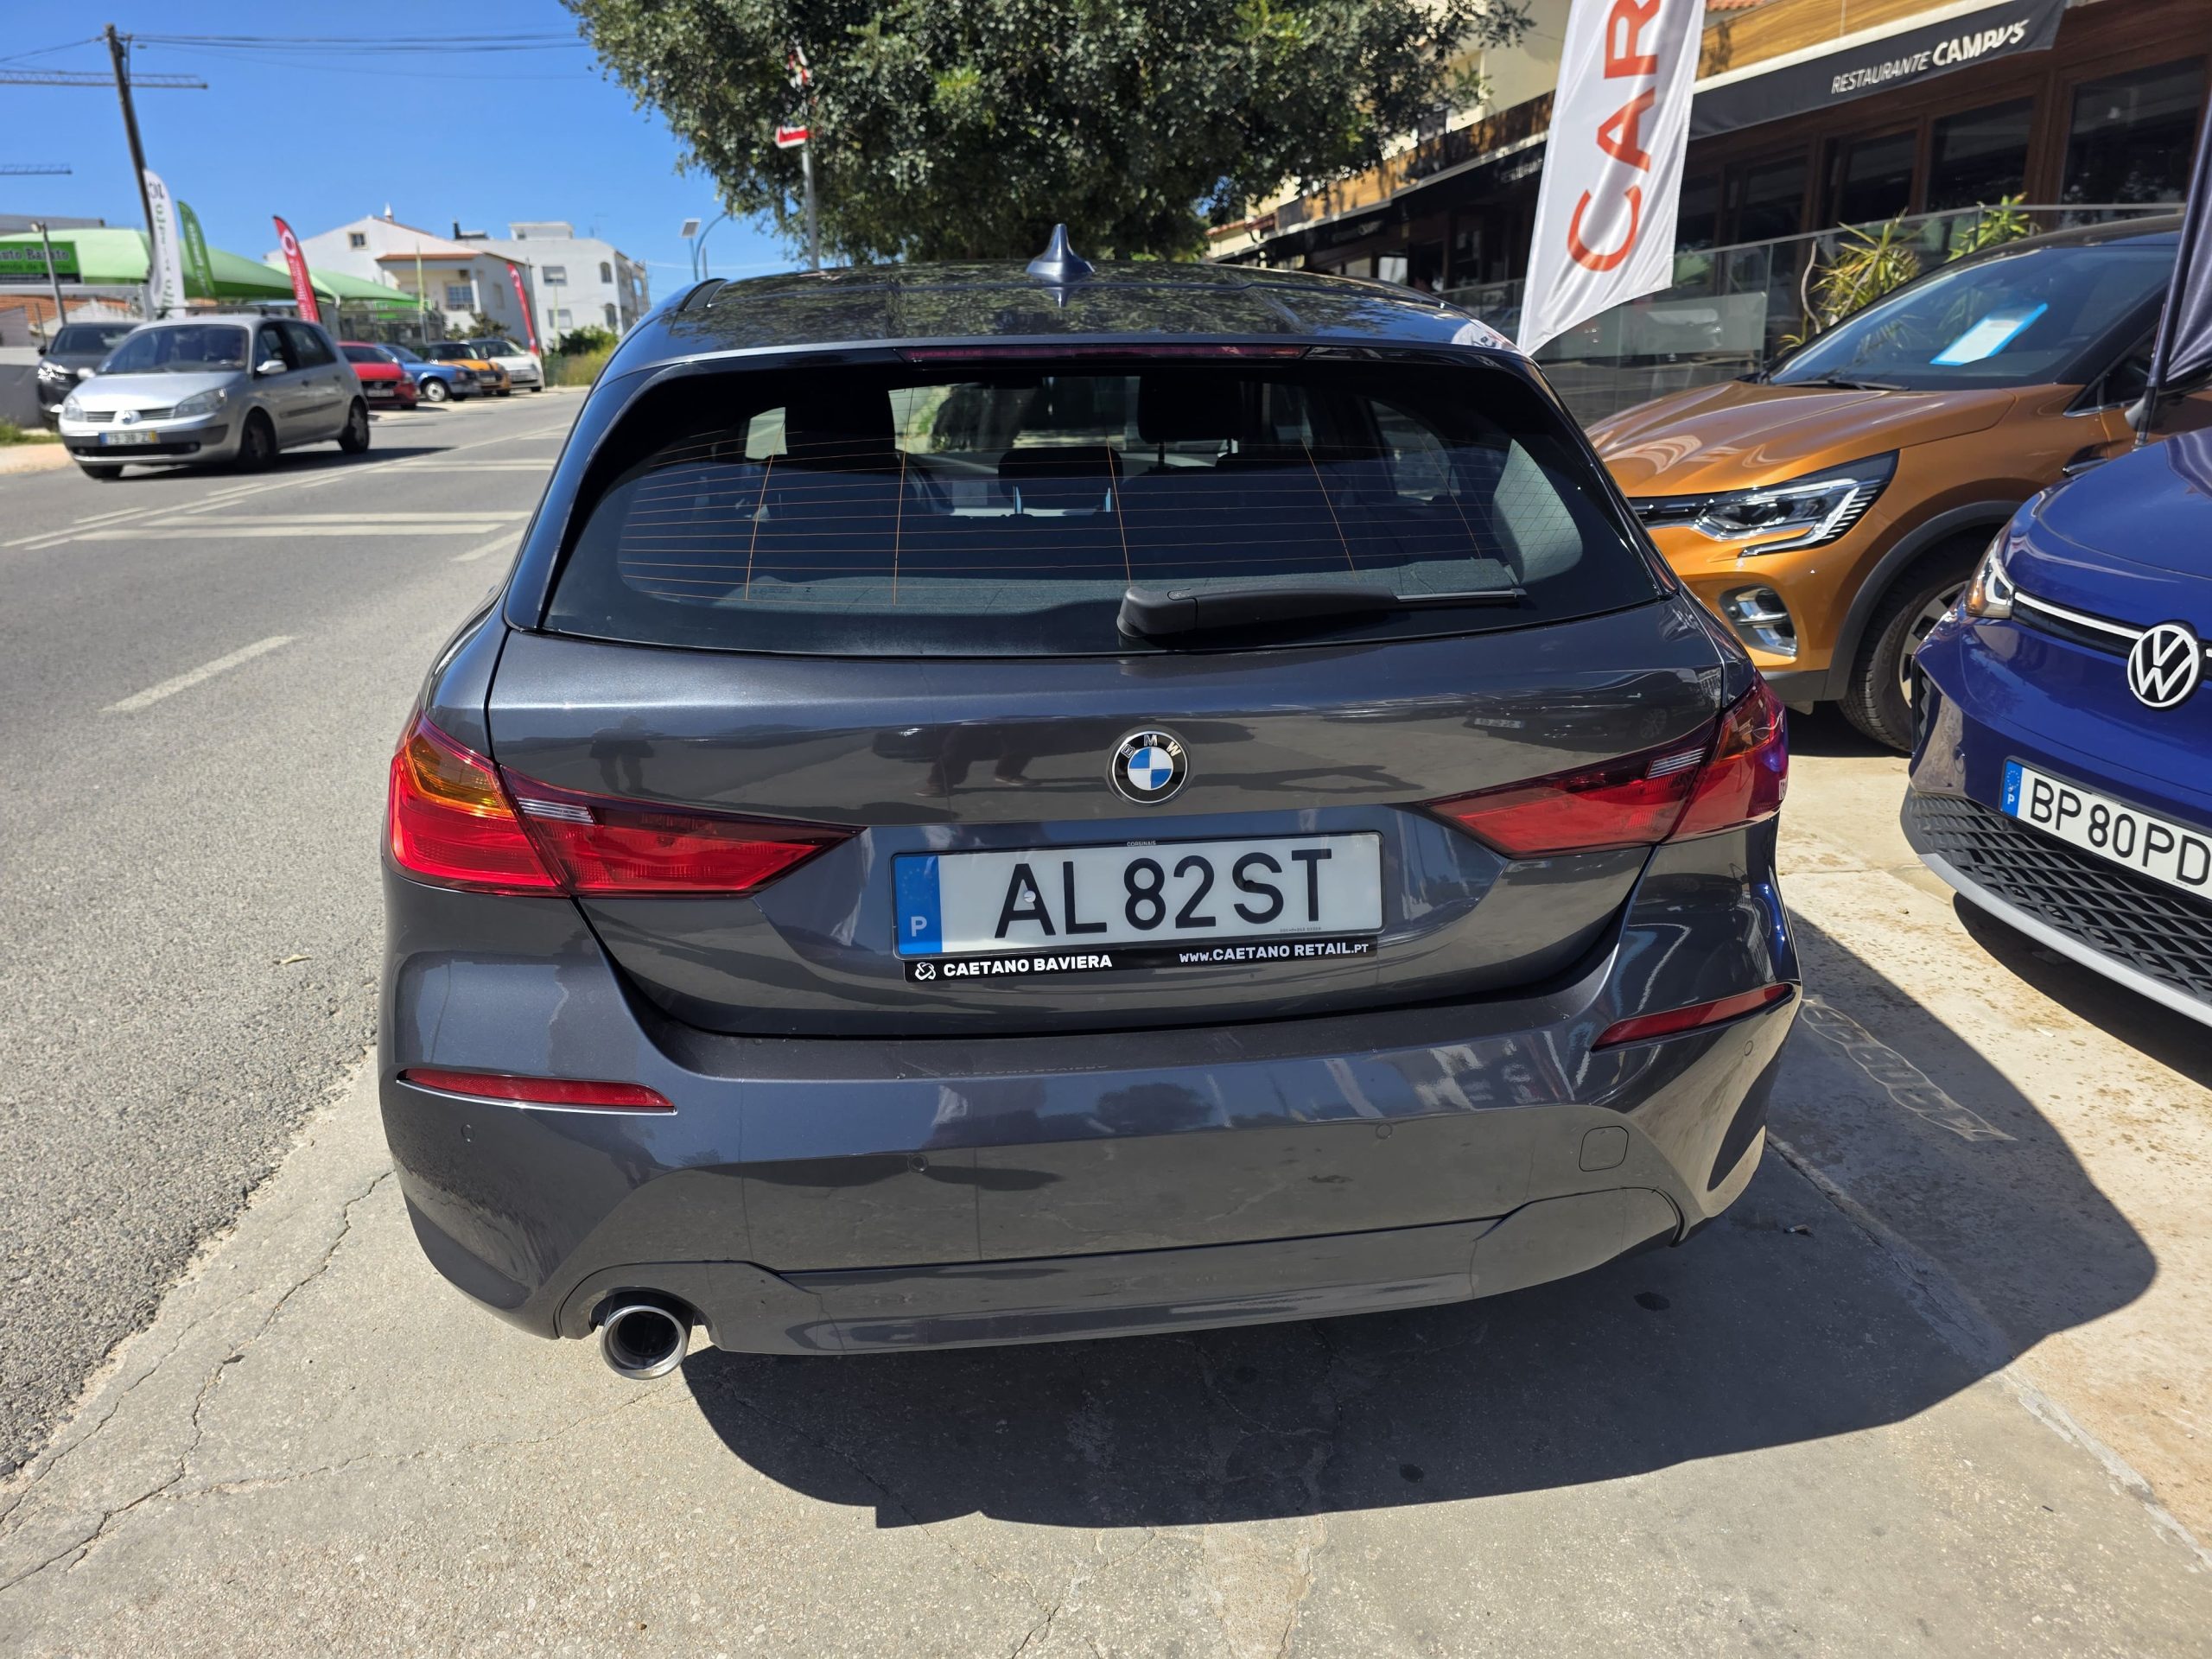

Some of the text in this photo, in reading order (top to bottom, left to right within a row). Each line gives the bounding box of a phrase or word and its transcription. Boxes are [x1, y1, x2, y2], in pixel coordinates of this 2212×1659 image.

[1832, 51, 1931, 93] RESTAURANTE
[1121, 734, 1181, 759] BMW
[2031, 778, 2082, 830] BP
[2088, 804, 2136, 858] 80
[2142, 823, 2211, 886] PD
[911, 849, 1332, 938] P AL 82 ST
[944, 955, 1112, 976] CAETANO BAVIERA
